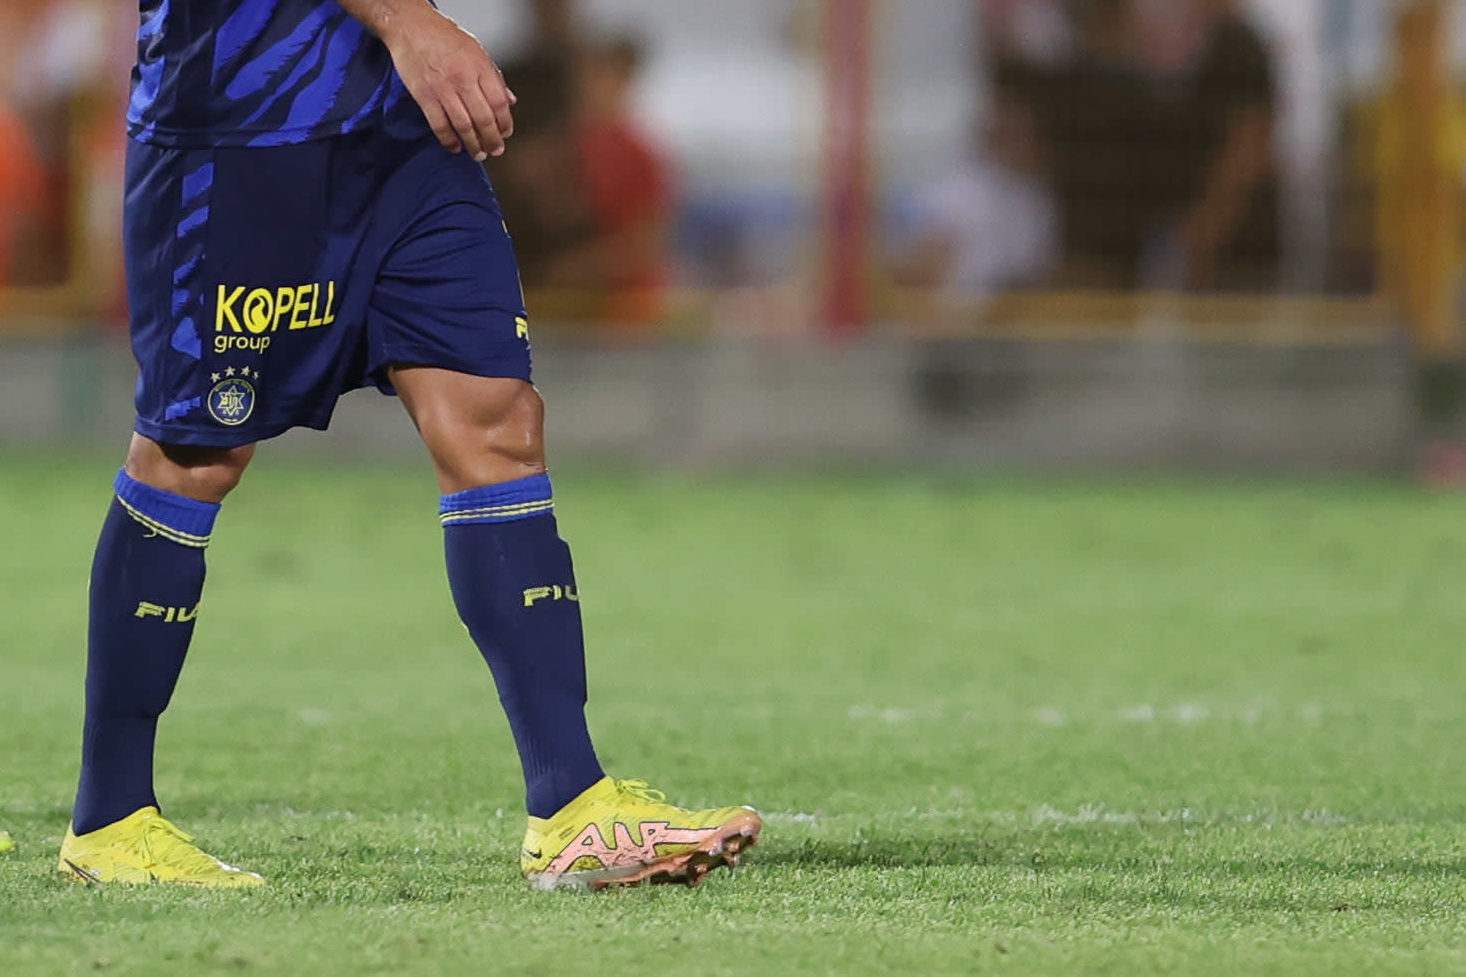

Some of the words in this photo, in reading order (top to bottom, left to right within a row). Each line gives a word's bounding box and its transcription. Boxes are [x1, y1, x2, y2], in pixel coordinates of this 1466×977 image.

[216, 281, 334, 334] KOPELL
[214, 334, 271, 354] group
[523, 584, 579, 606] FIL
